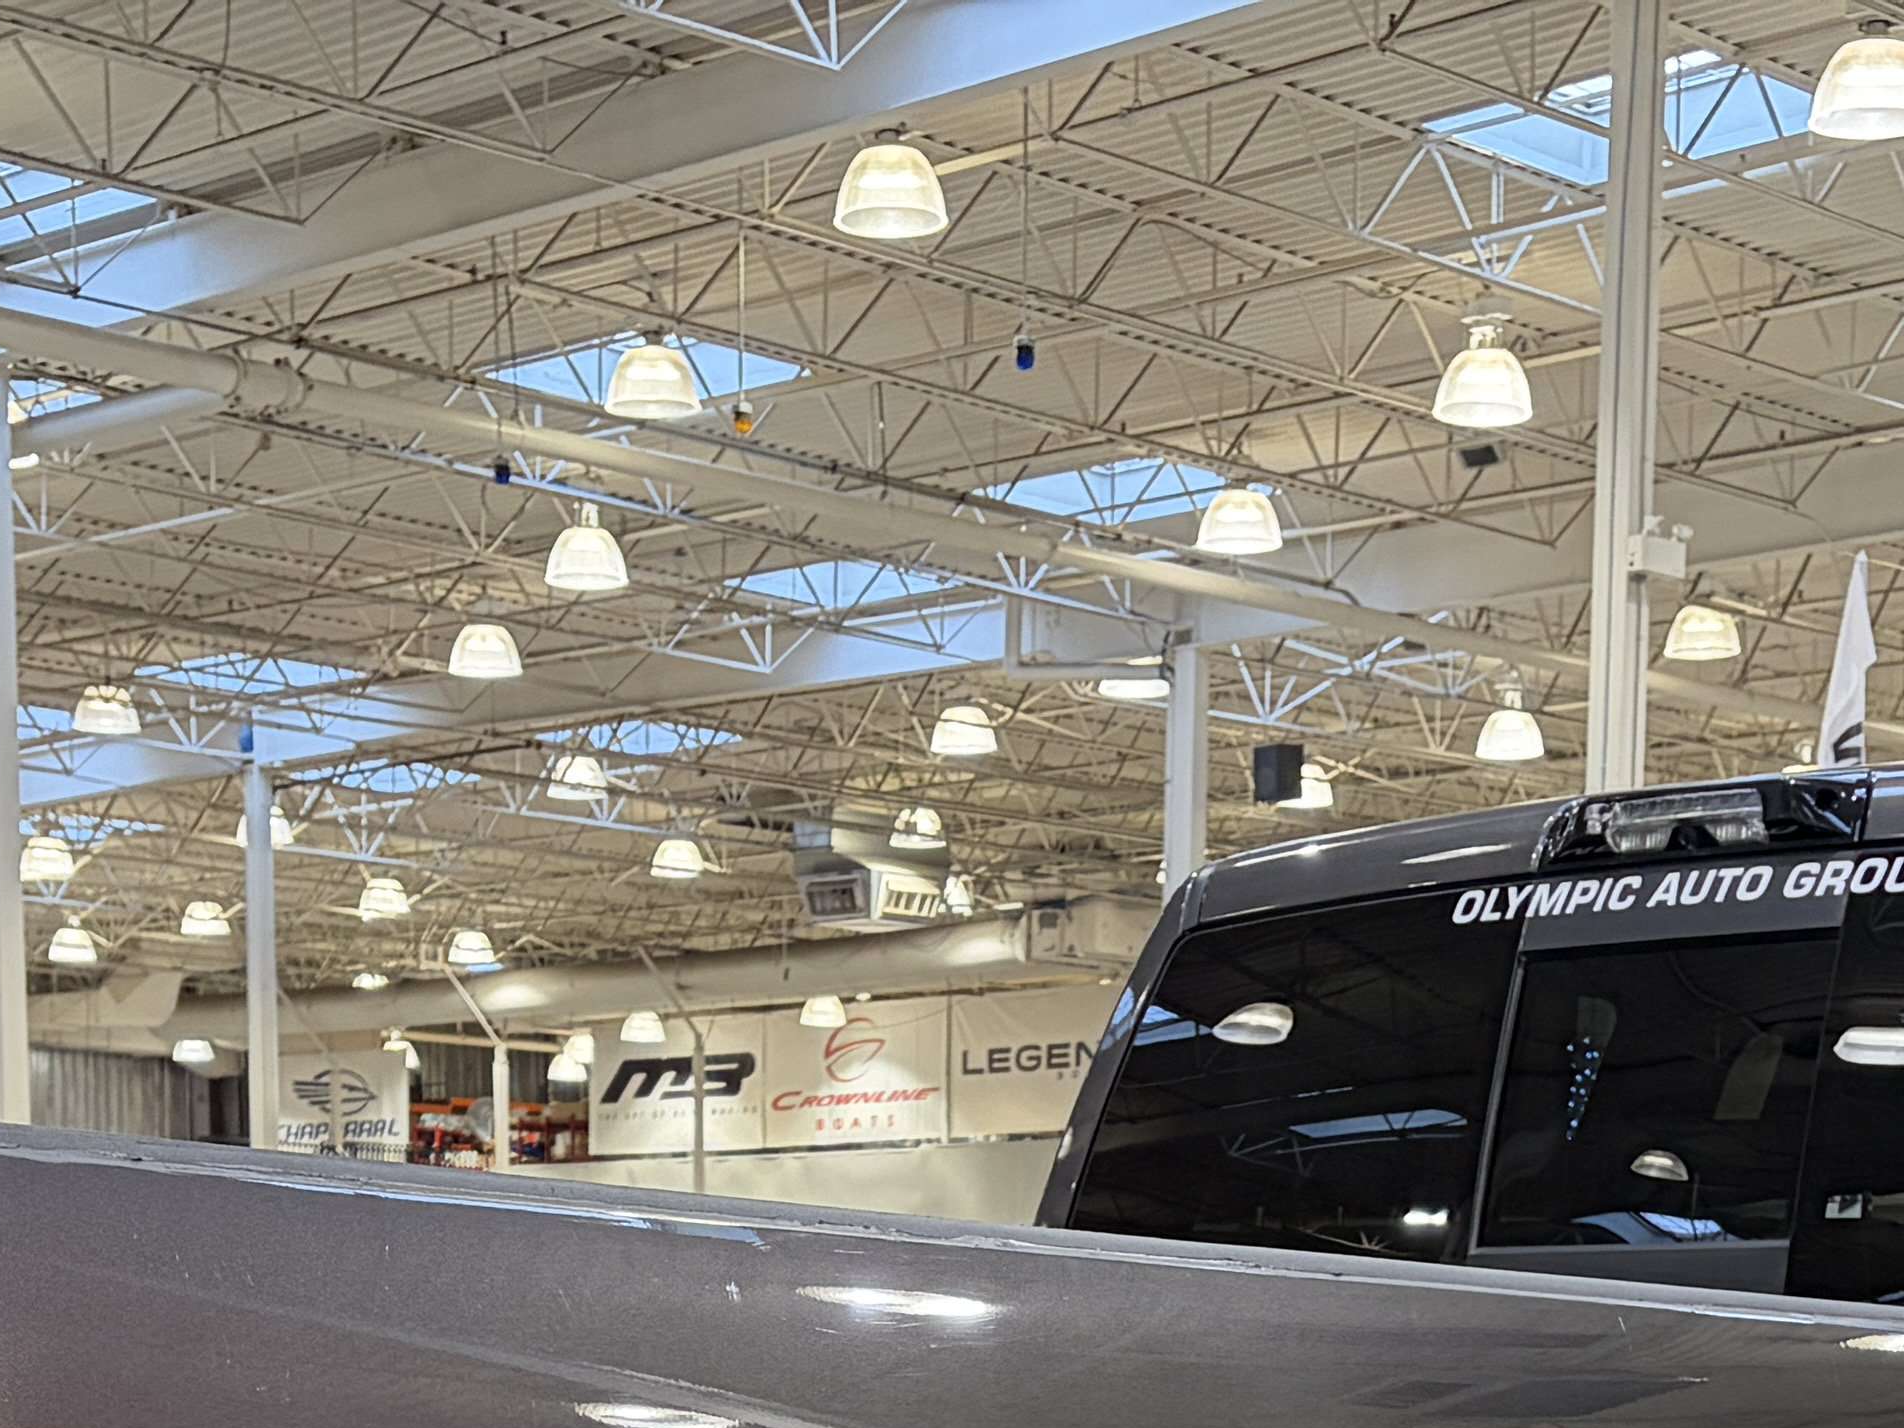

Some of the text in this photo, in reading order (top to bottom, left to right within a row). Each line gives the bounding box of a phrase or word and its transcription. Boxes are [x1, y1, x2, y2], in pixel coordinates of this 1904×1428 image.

[1451, 874, 1641, 924] OLYMPIC
[1646, 864, 1773, 909] AUTO
[771, 1086, 941, 1112] CROWNLINE
[815, 1114, 897, 1132] BOATS
